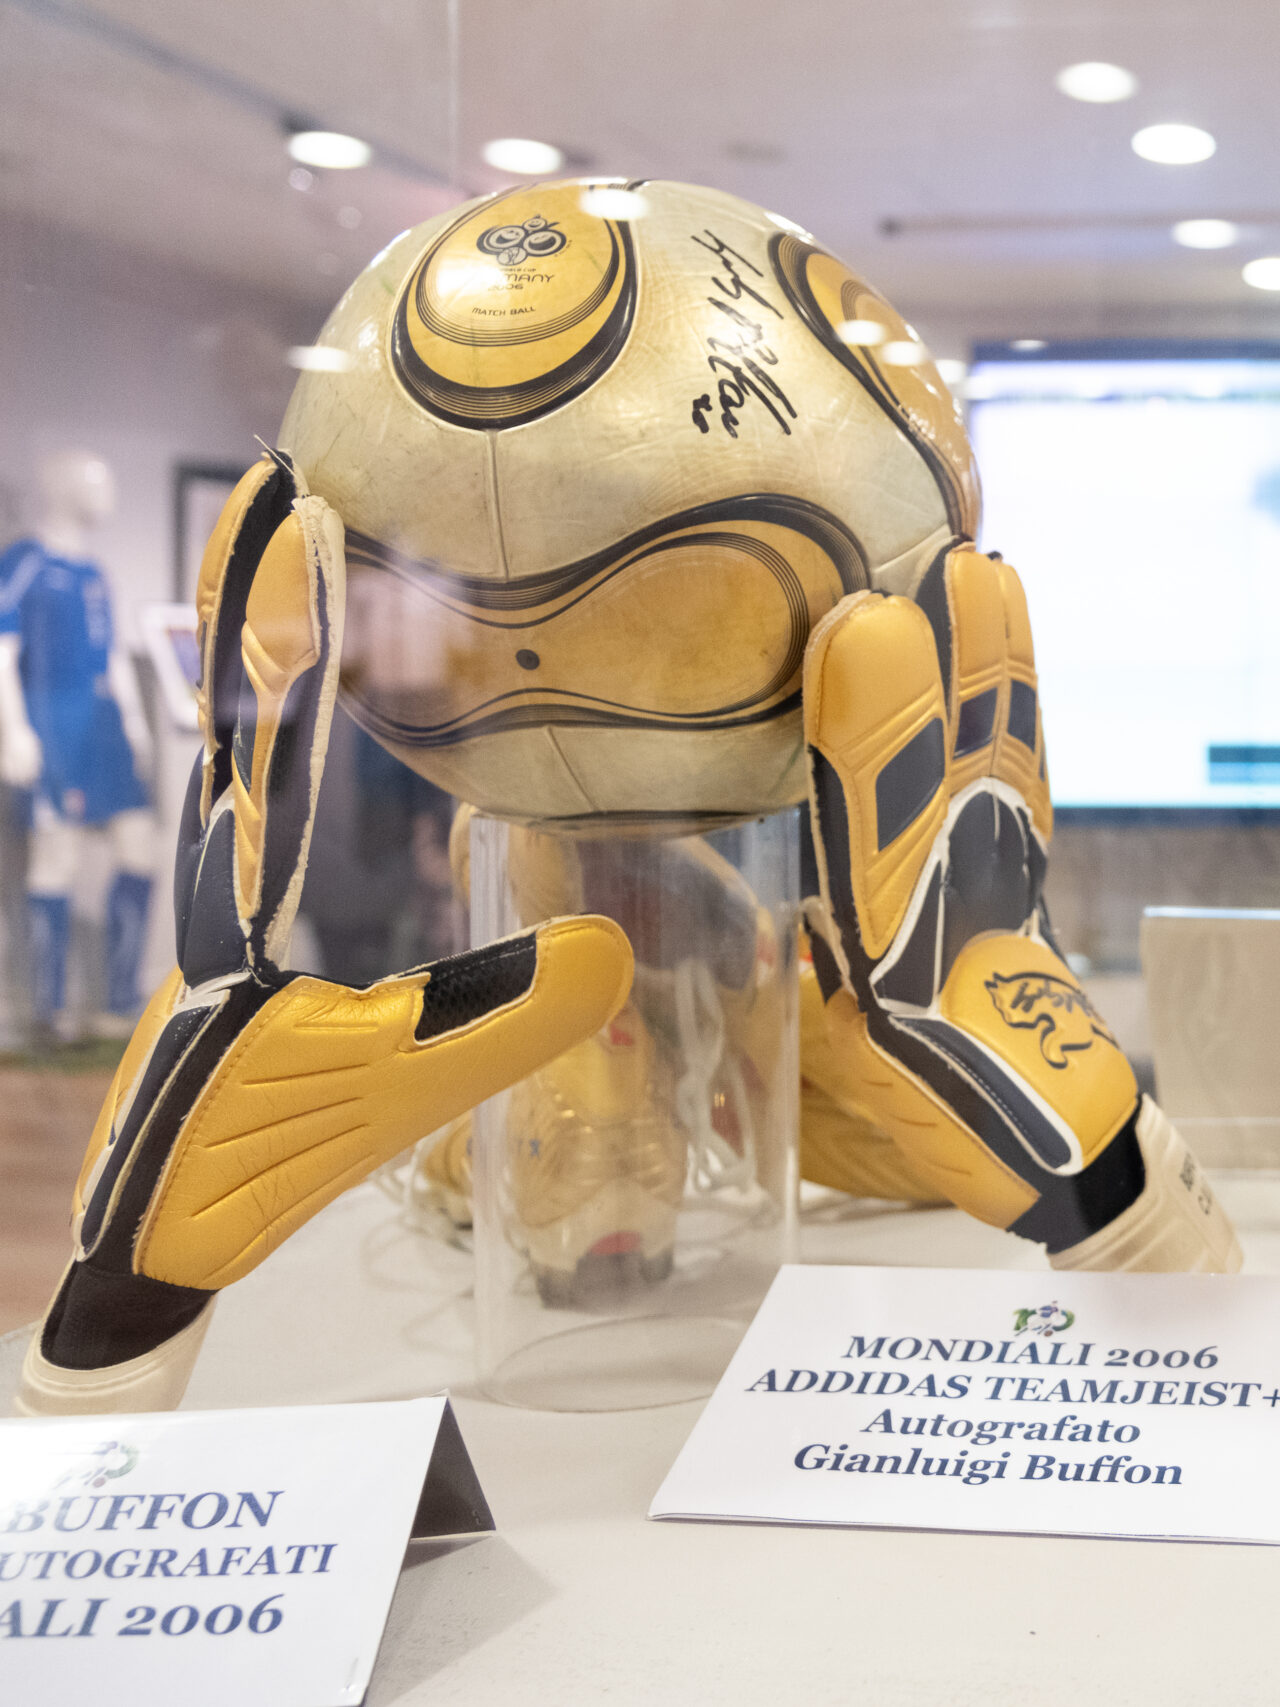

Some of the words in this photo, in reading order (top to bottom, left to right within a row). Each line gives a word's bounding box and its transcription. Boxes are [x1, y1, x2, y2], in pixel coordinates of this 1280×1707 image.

[471, 306, 506, 317] MATCH
[509, 306, 537, 316] BALL
[841, 1335, 1096, 1367] MONDIALI
[1103, 1345, 1219, 1369] 2006
[744, 1368, 971, 1399] ADDIDAS
[859, 1408, 1141, 1446] Autografato
[793, 1443, 1009, 1486] Gianluigi
[1019, 1454, 1183, 1485] Buffon
[2, 1490, 285, 1533] BUFFON
[117, 1593, 284, 1637] 2006
